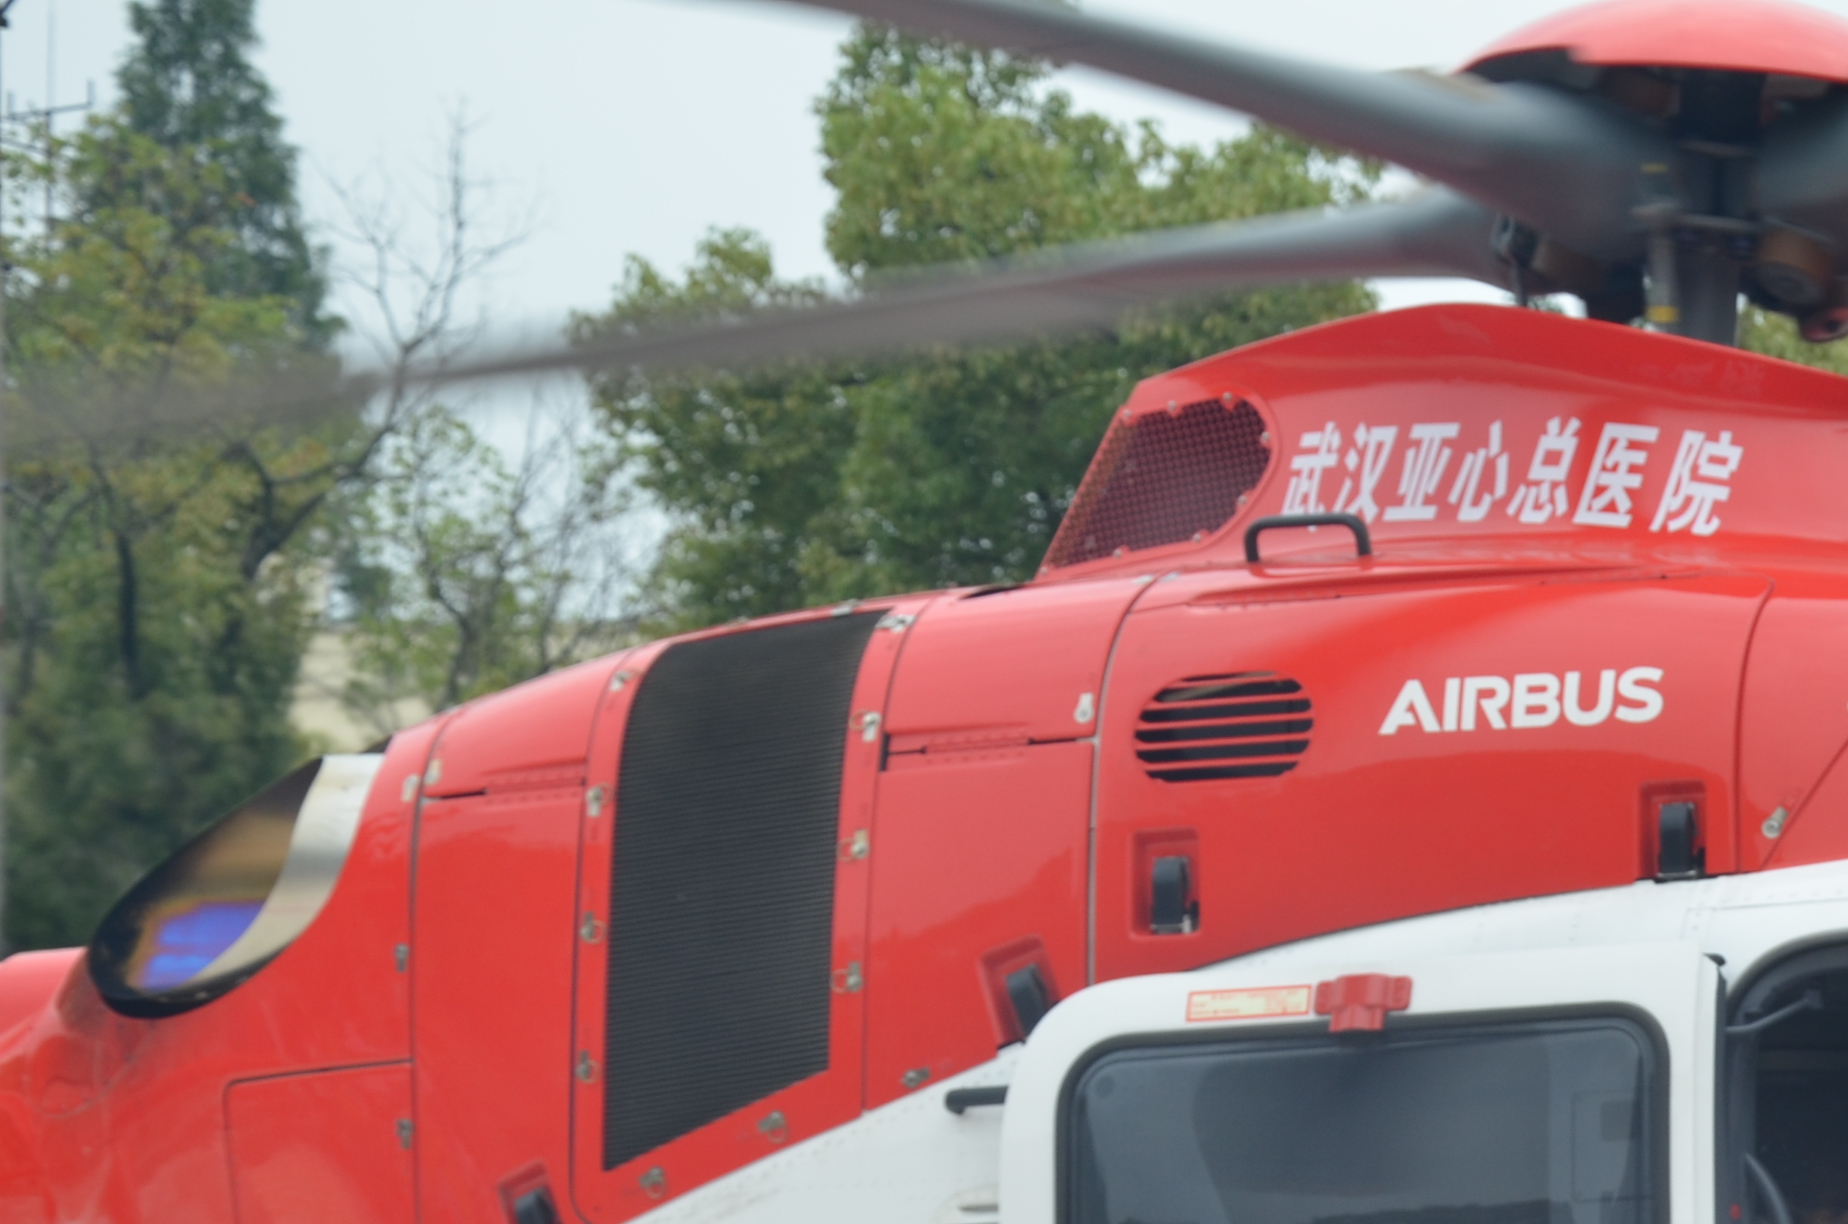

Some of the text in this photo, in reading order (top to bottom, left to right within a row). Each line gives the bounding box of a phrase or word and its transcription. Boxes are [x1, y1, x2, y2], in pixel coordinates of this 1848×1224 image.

[1281, 416, 1743, 536] 武汉亚心总医院
[1378, 666, 1663, 735] AIRBUS
